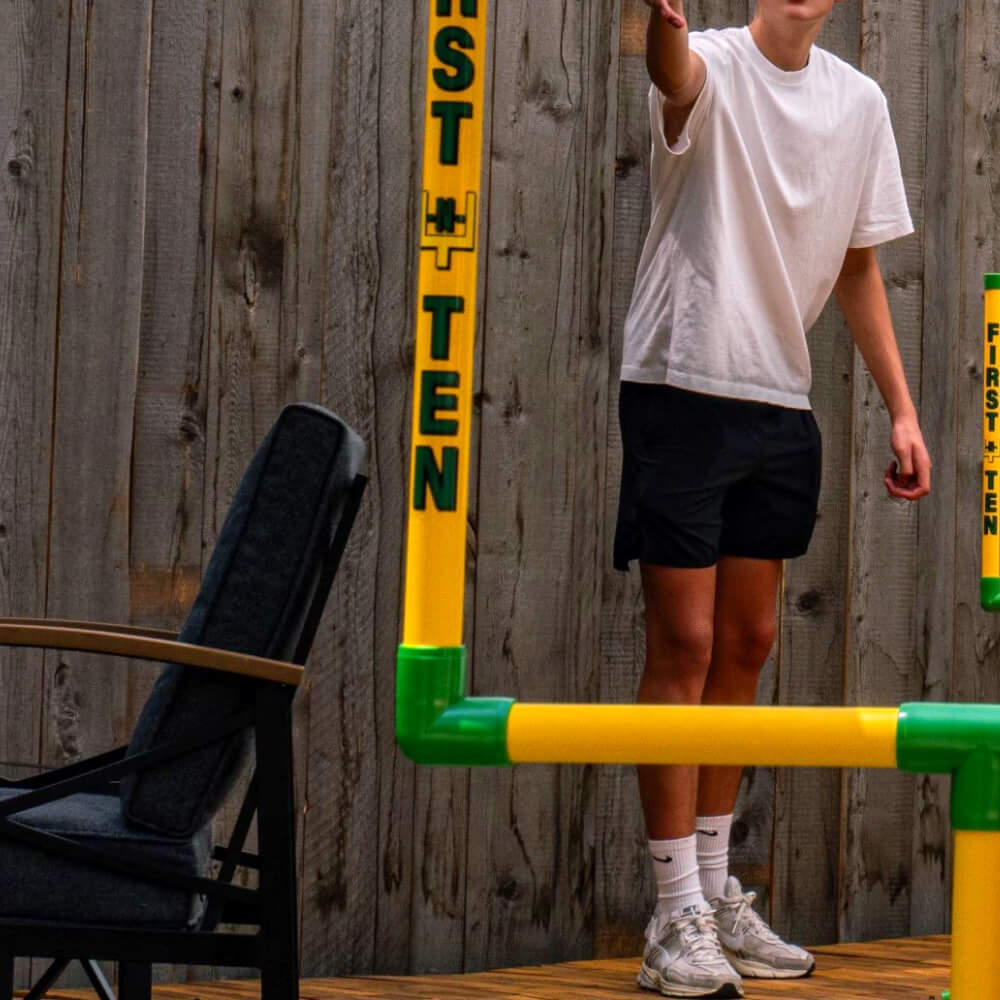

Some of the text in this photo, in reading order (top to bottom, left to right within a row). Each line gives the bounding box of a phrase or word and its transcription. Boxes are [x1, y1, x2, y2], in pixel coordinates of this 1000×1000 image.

[413, 295, 466, 512] TEN
[983, 323, 1000, 535] FIRST TEN
